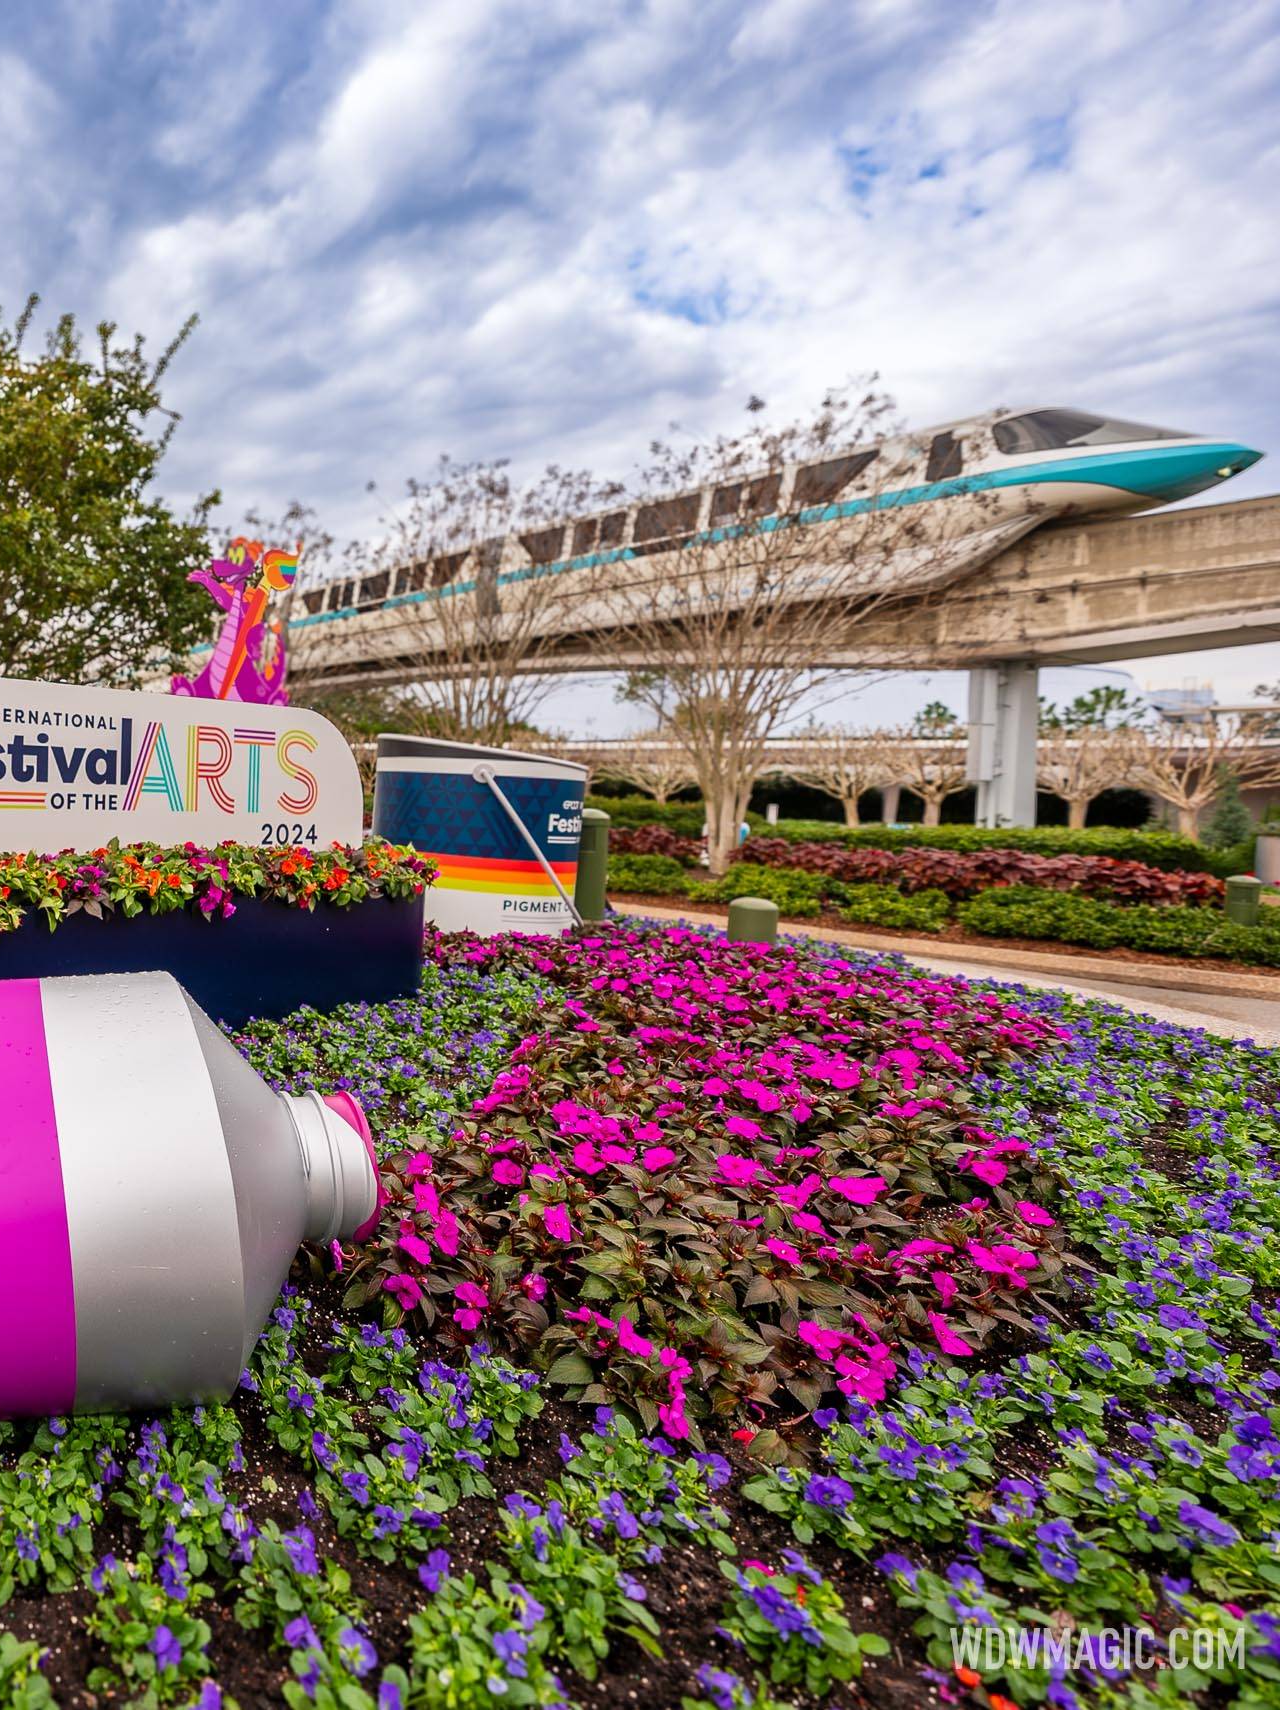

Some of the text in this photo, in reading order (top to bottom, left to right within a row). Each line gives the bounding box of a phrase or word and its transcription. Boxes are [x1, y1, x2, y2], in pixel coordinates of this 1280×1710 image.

[122, 721, 318, 815] ARTS
[51, 793, 118, 810] OF THE
[261, 823, 318, 845] 2024
[503, 900, 563, 913] PIGMENT
